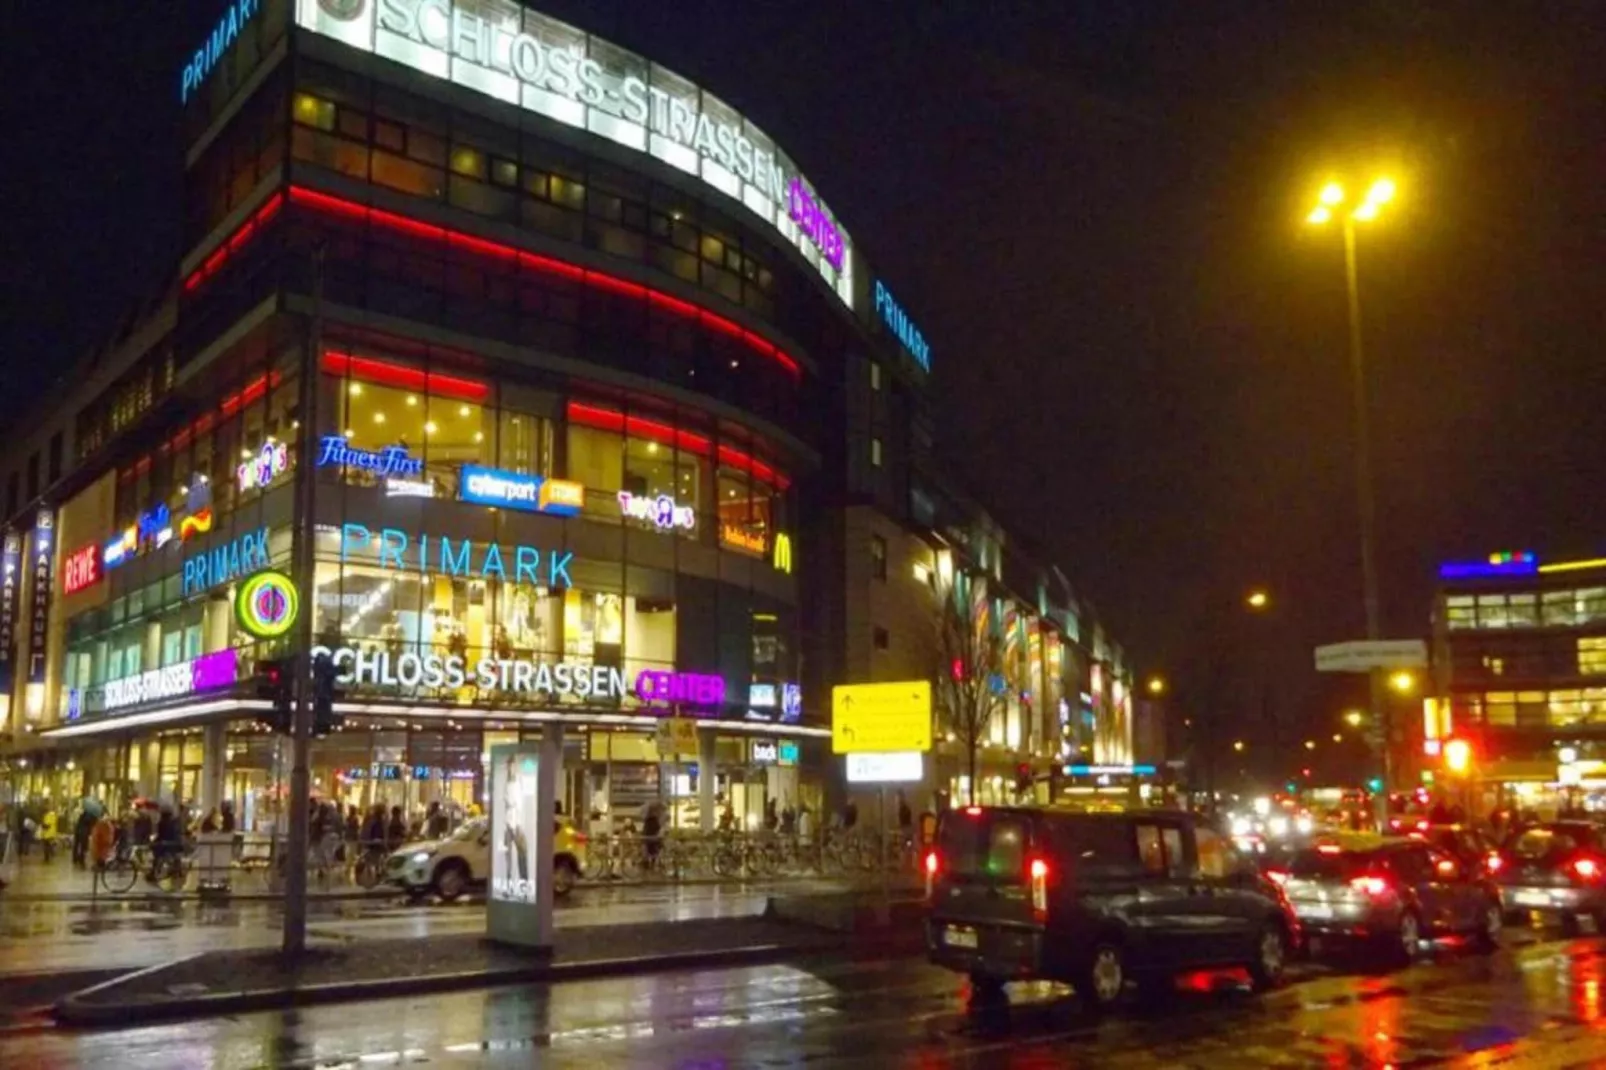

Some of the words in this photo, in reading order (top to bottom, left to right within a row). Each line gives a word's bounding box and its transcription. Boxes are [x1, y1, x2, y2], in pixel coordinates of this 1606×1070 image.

[182, 0, 258, 104] PRIMAR
[875, 279, 930, 374] PRIMARK
[65, 545, 97, 592] REWE
[183, 528, 268, 596] PRIMARK
[343, 523, 574, 588] PRIMARK
[634, 668, 726, 704] CENTER
